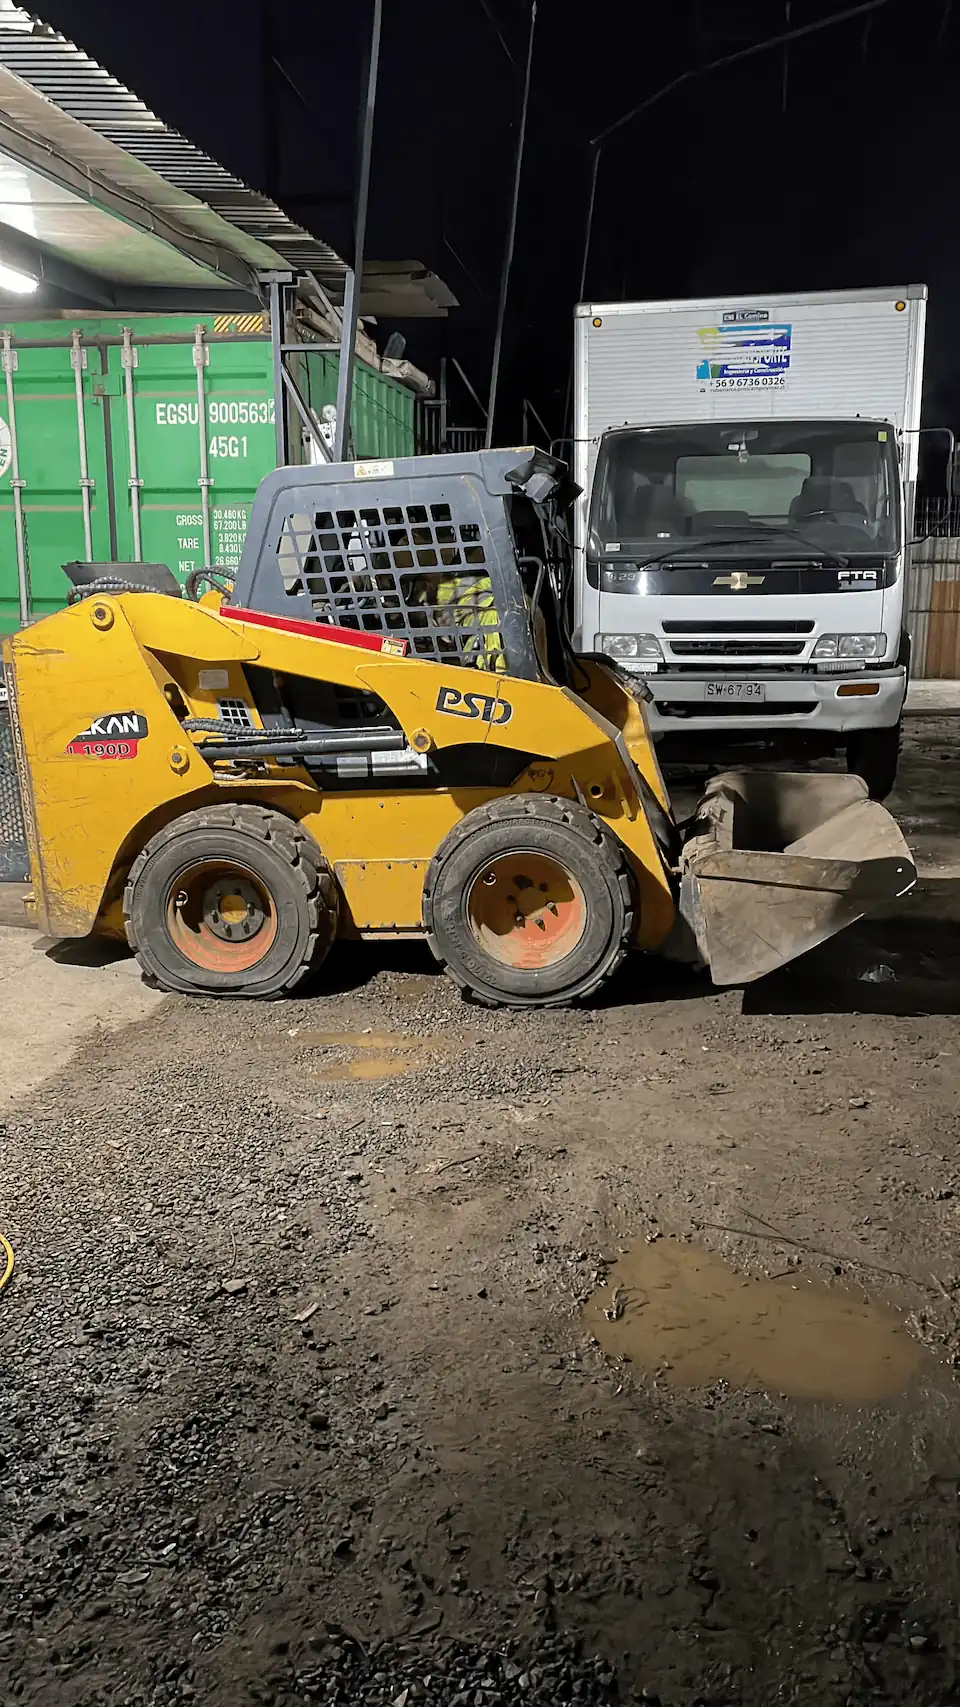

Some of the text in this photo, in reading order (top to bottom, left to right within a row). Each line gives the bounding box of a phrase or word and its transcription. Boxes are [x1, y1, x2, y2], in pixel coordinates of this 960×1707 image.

[728, 379, 735, 387] 9
[736, 378, 760, 387] 6736
[762, 377, 785, 386] 0326
[155, 403, 199, 425] EGSU
[208, 435, 248, 458] 45G1
[176, 514, 203, 526] GROSS
[177, 537, 200, 549] TARE
[178, 560, 195, 572] NET
[837, 570, 878, 581] FTR
[435, 685, 513, 724] PSD
[83, 743, 130, 756] 190D
